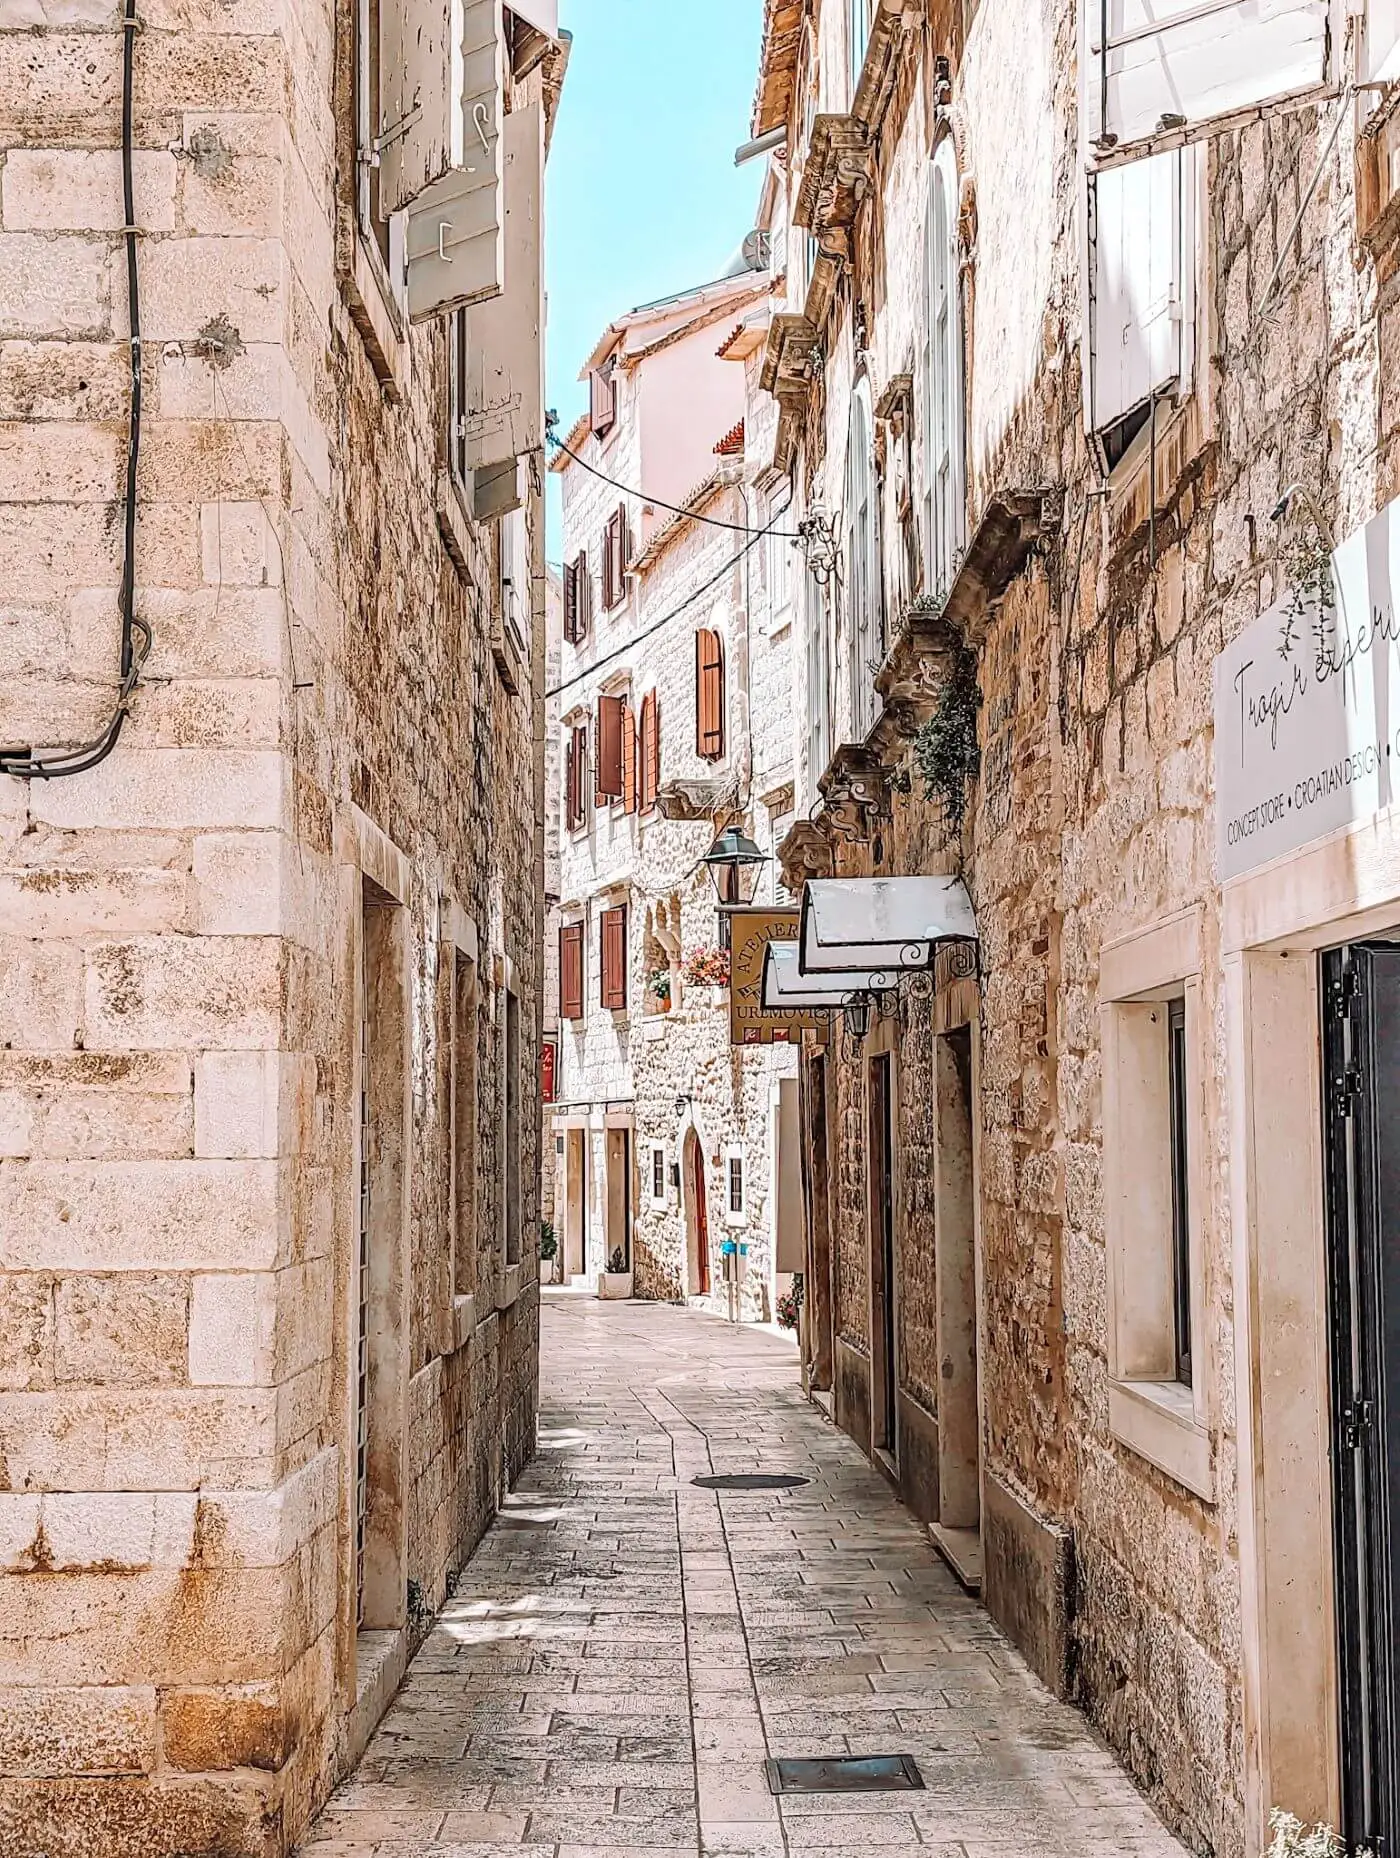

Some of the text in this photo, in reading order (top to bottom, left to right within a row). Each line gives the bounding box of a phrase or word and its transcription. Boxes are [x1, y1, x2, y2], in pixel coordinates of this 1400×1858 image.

[1234, 659, 1308, 769] Trogir
[1227, 807, 1260, 846] CONCEPT
[1260, 793, 1286, 828] STORE
[1293, 761, 1344, 810] CROATIAN
[1344, 739, 1382, 785] DESIGN
[736, 922, 799, 975] ATELIER
